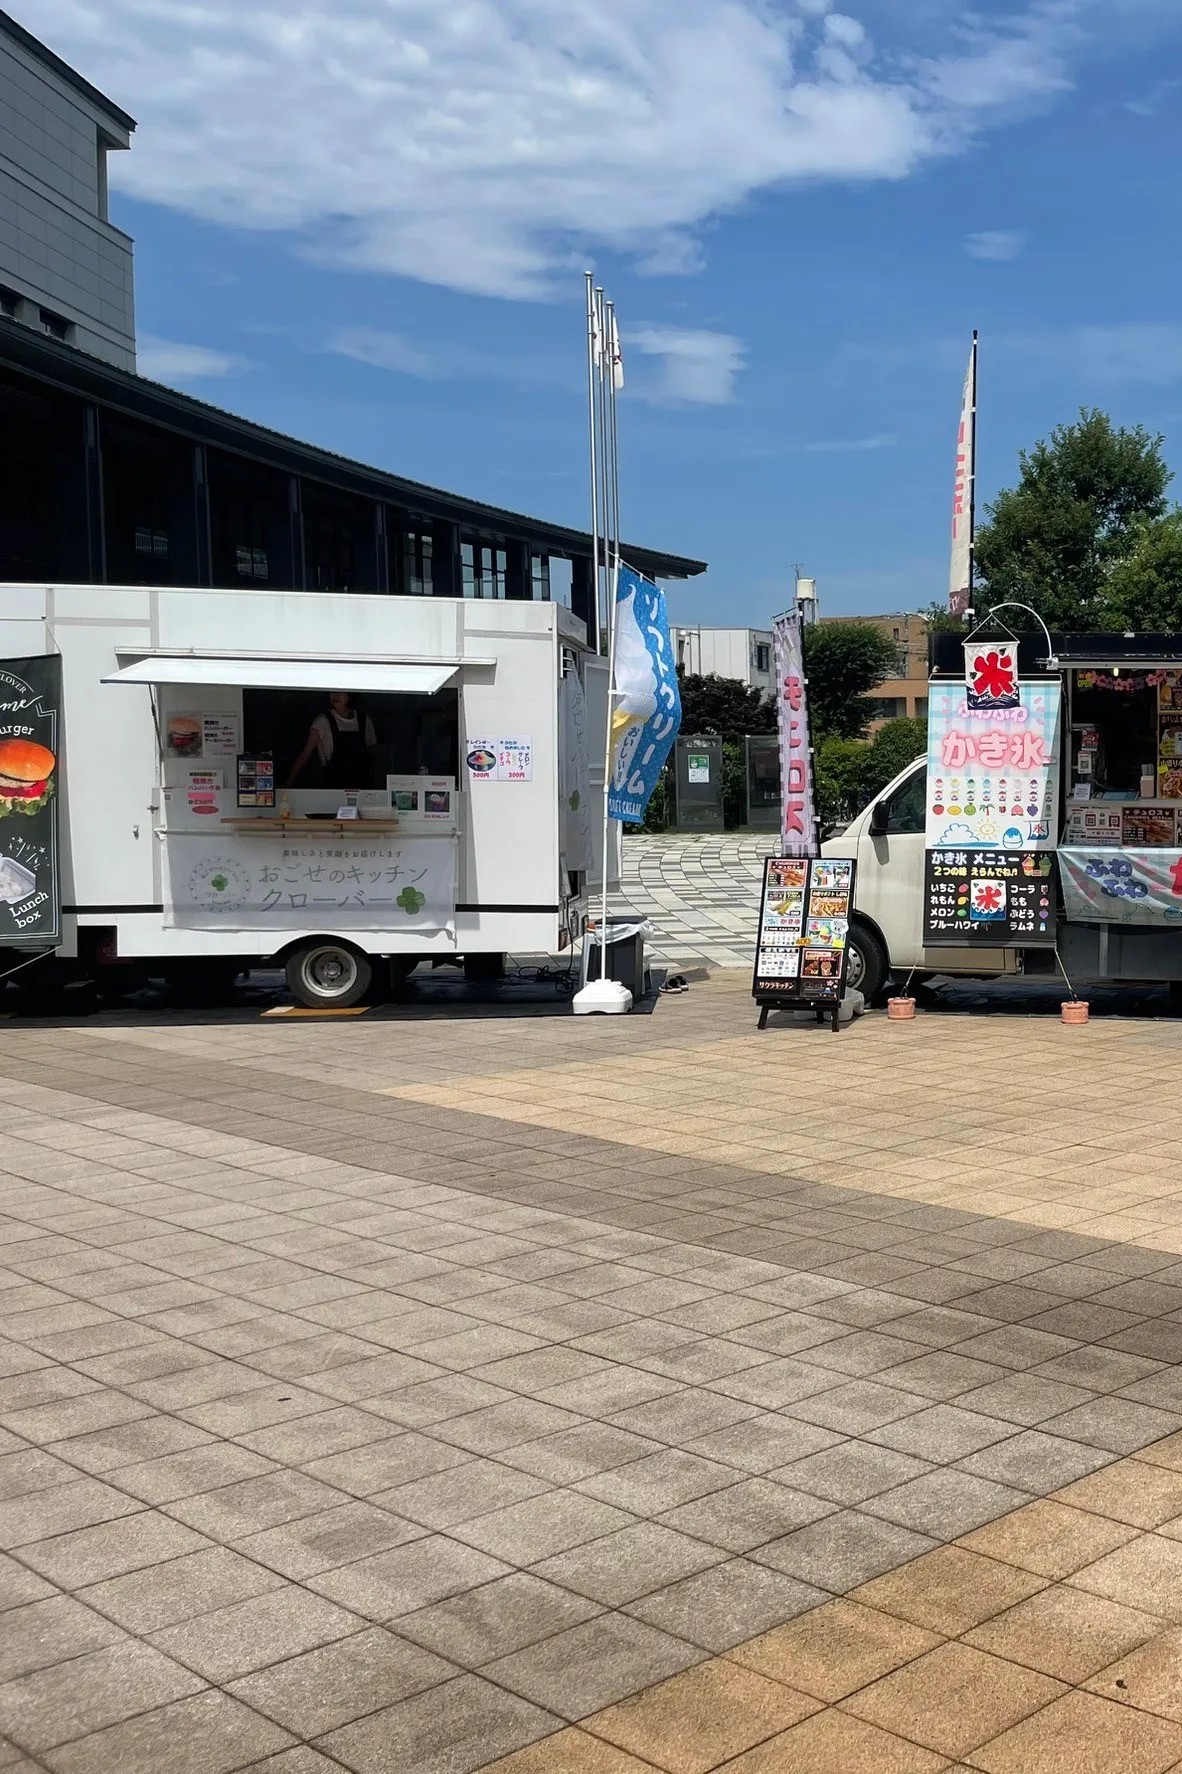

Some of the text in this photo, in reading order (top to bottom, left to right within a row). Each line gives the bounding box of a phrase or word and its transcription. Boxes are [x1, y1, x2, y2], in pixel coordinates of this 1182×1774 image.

[0, 671, 27, 694] LOVER
[973, 652, 1014, 698] 氷
[942, 731, 1044, 770] かき氷
[1133, 809, 1164, 817] チュロス
[282, 850, 403, 858] 美味しさと笑顔をお届けします
[931, 851, 1020, 866] かき氷 メニュー
[258, 862, 429, 885] おごせのキッチン
[1085, 858, 1133, 878] ふわ
[930, 883, 1036, 894] いちご コーラ
[974, 885, 1002, 911] 氷
[1101, 878, 1149, 898] ふわ
[9, 890, 50, 918] Lunch
[261, 888, 392, 913] クローバー
[930, 895, 1028, 907] れもん もも
[15, 910, 42, 929] box
[930, 908, 1035, 919] メロン ぶどう
[929, 919, 1035, 931] ブルーハワイ ラムネ
